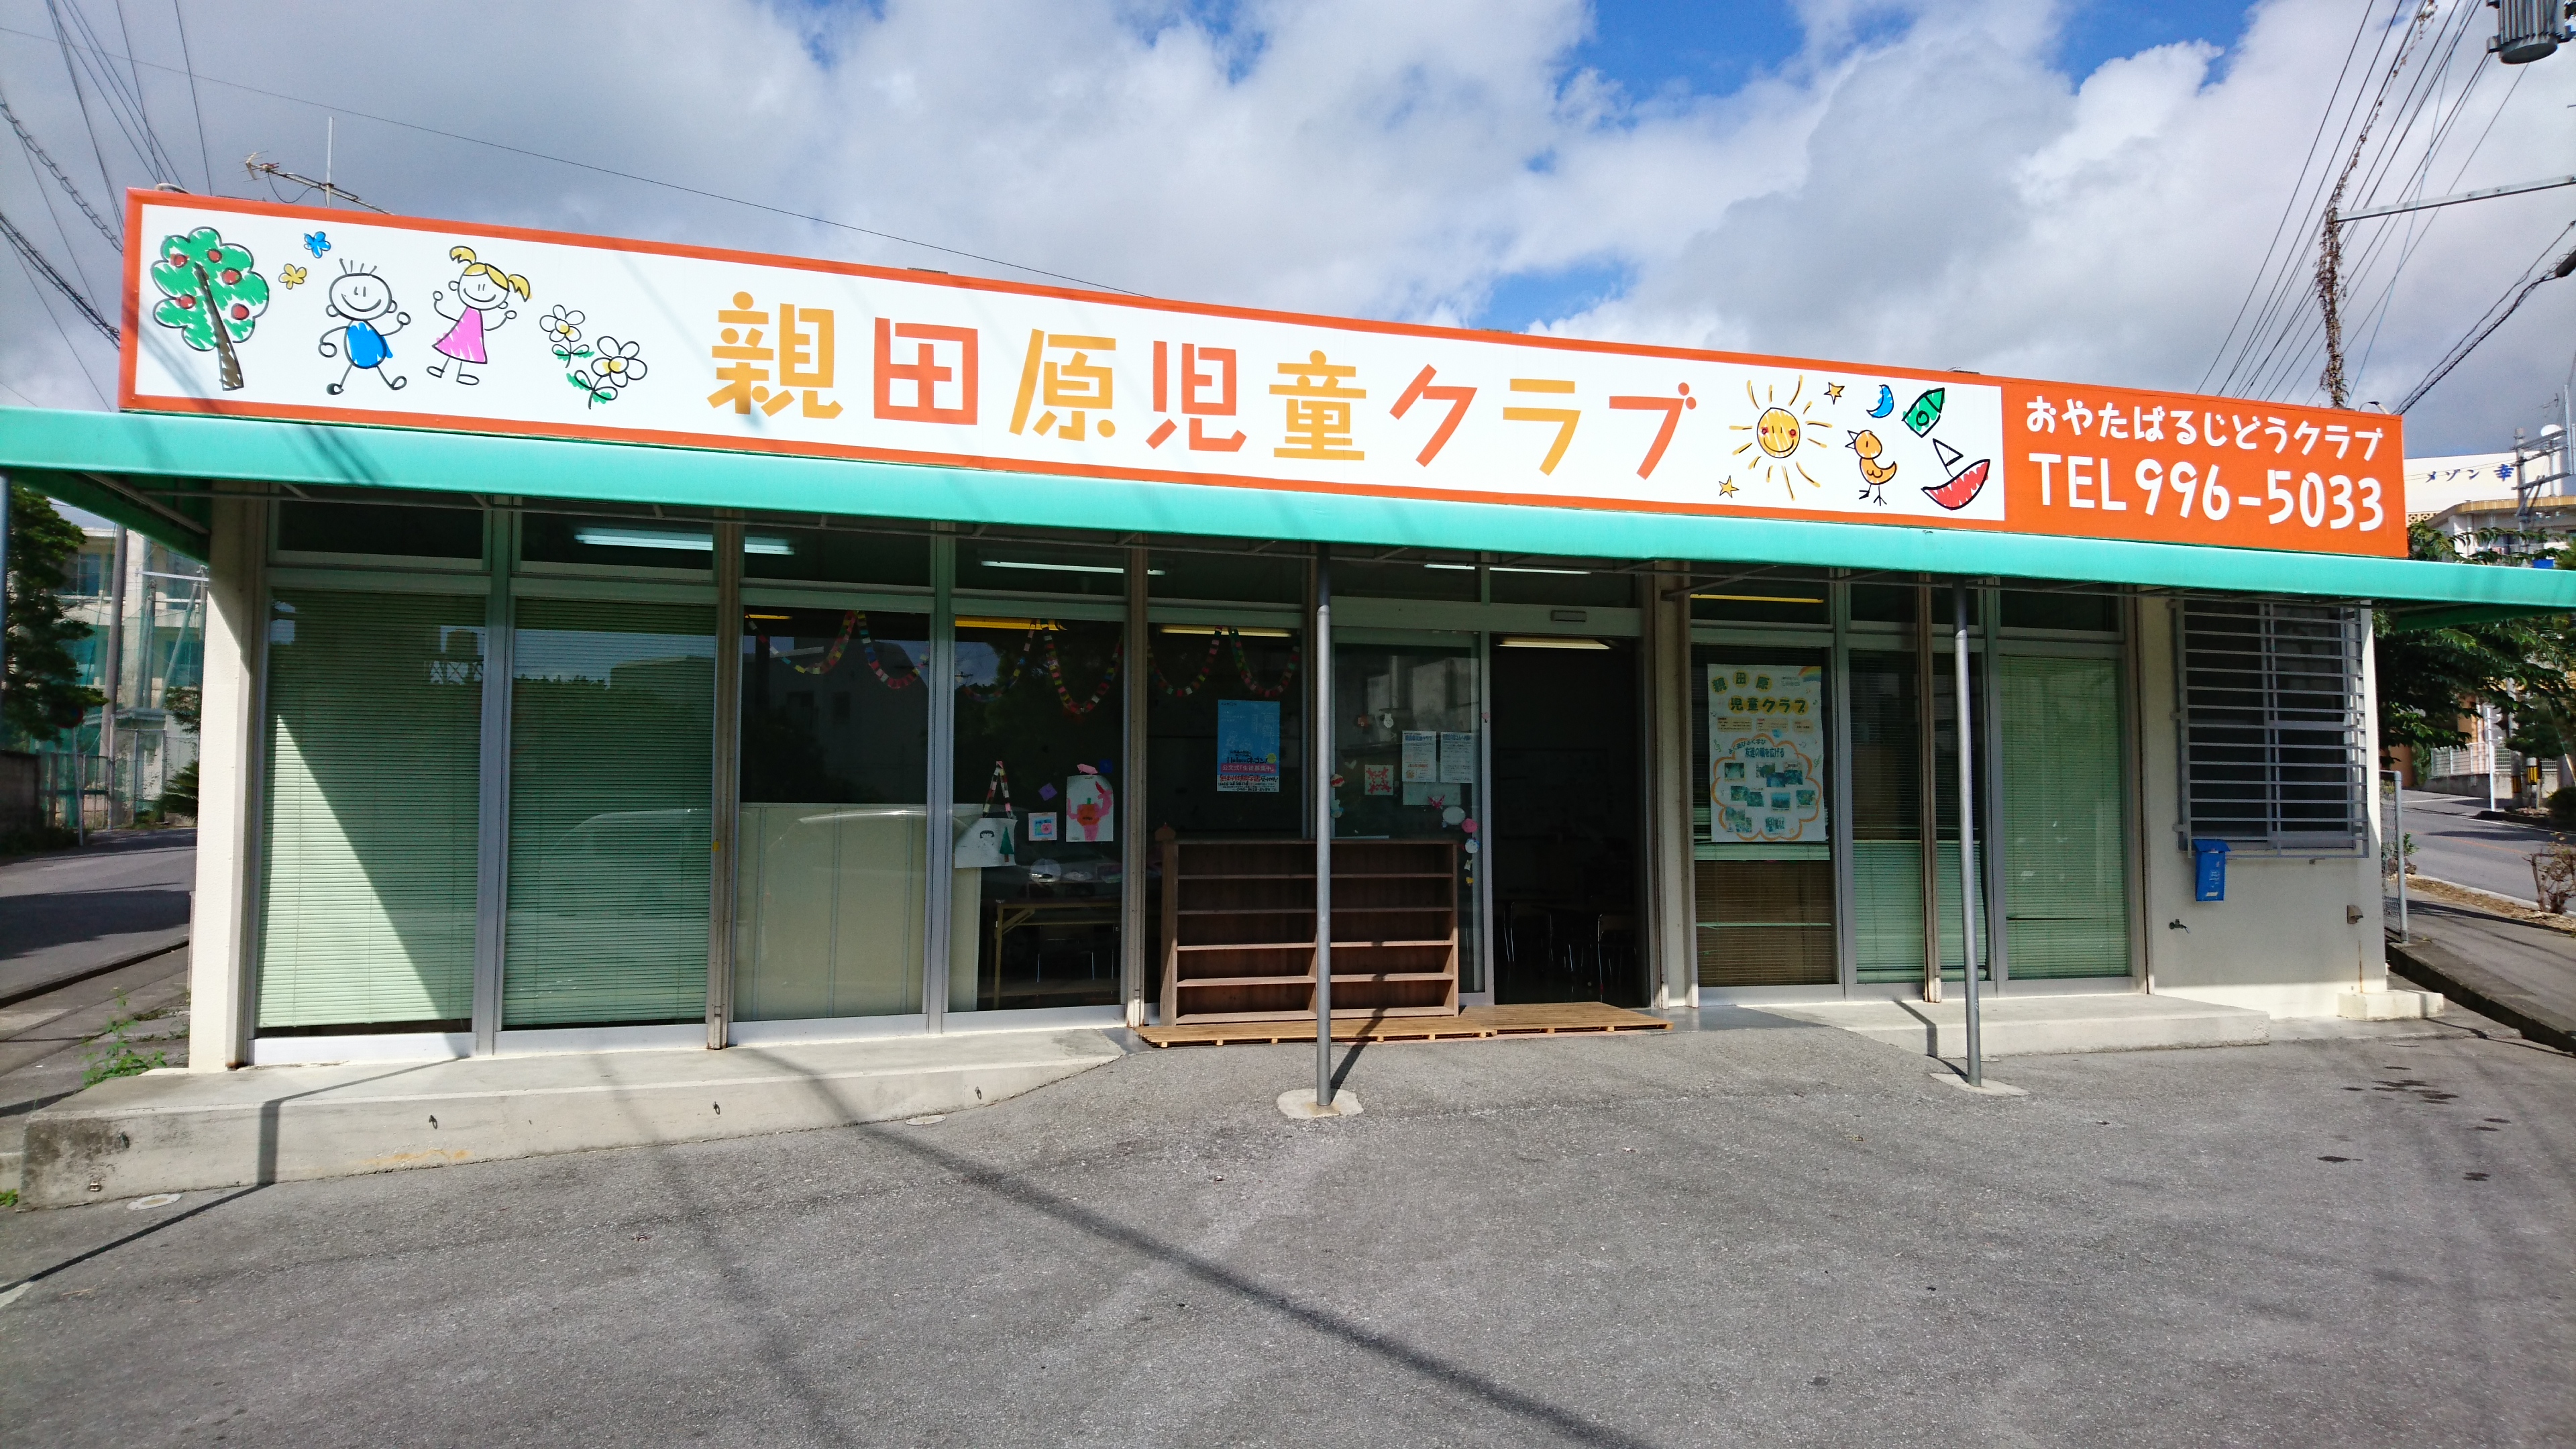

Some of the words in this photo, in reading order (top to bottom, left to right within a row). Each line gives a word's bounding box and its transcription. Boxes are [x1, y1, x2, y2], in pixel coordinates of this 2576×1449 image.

[707, 291, 1697, 480] 親田原児童クラブ
[2026, 395, 2383, 462] おやたばるじどうクラブ
[2029, 452, 2127, 511] TEL
[2135, 458, 2384, 531] 996-5033
